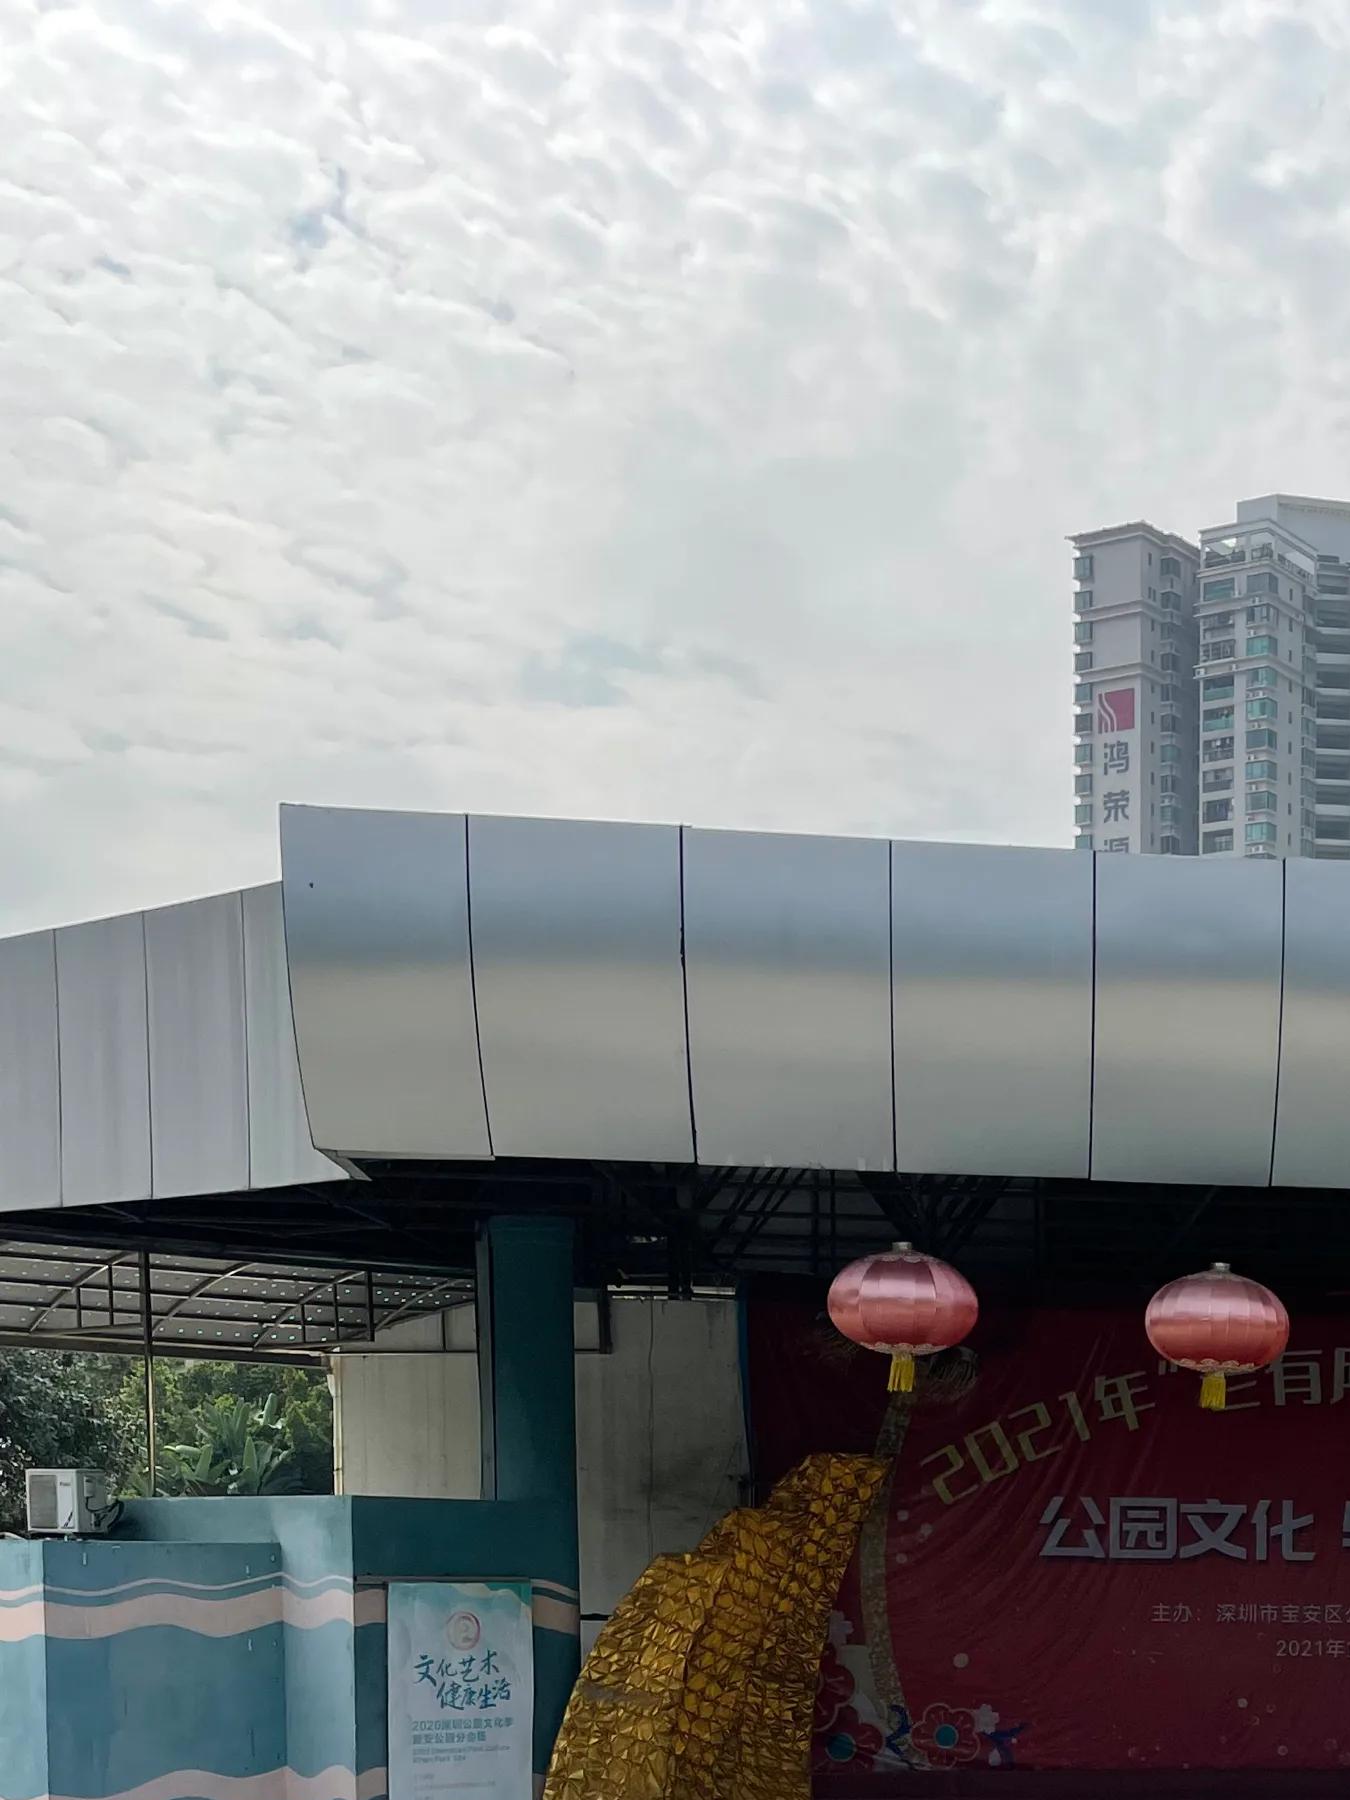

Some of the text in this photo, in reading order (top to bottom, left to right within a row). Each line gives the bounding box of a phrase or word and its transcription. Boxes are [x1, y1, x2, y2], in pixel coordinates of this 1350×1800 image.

[1038, 1496, 1315, 1563] 公园文化
[414, 1648, 500, 1687] 文化艺术
[436, 1677, 512, 1711] 健康生活
